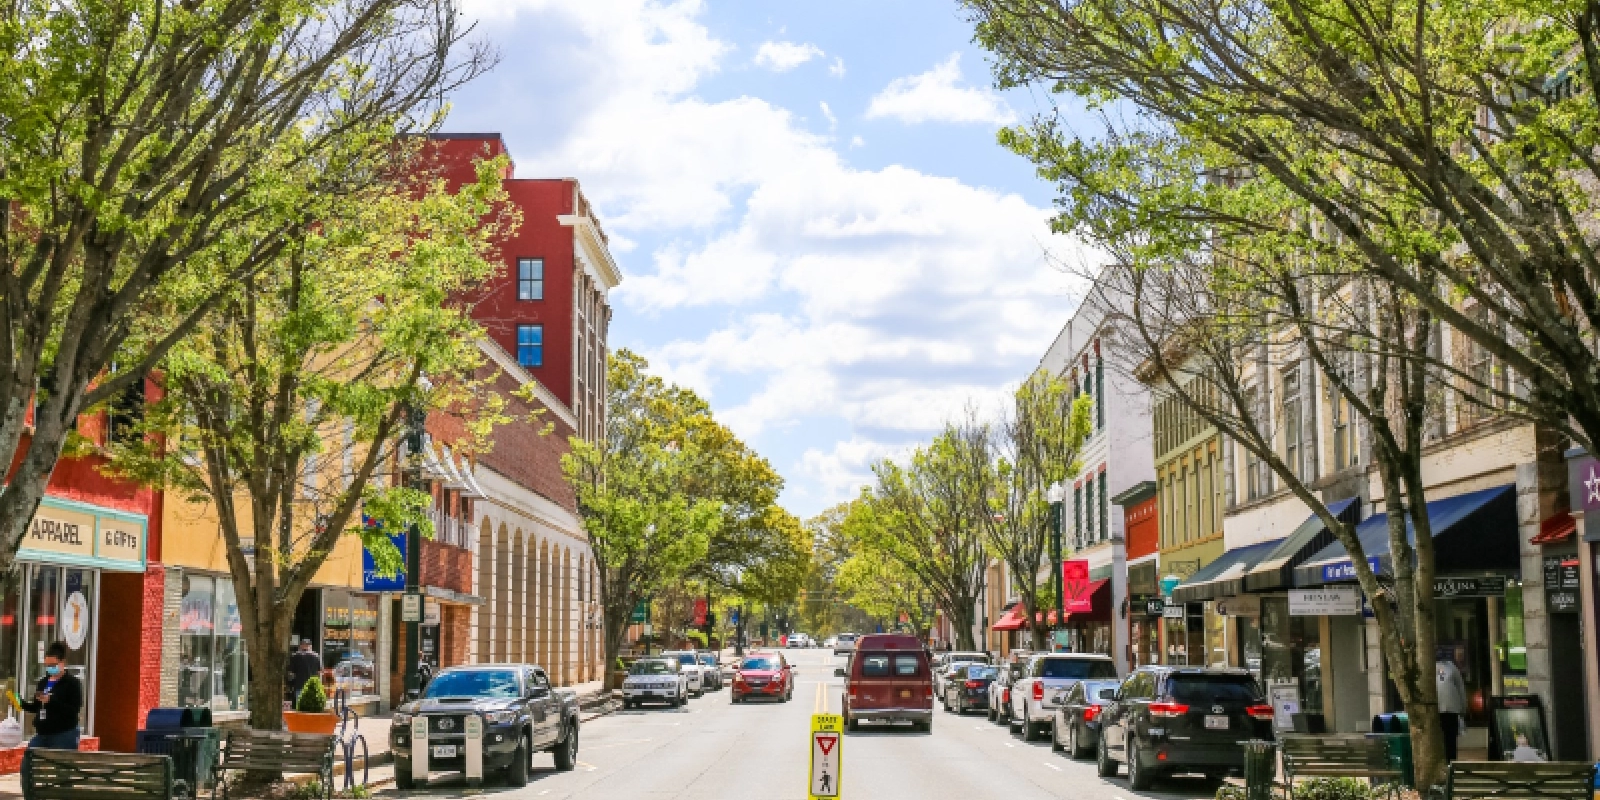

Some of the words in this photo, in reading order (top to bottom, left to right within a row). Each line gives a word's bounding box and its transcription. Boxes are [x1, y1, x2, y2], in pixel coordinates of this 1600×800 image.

[31, 518, 83, 545] APPAREL
[114, 531, 137, 549] GIFTS
[1433, 582, 1476, 592] AROLINA
